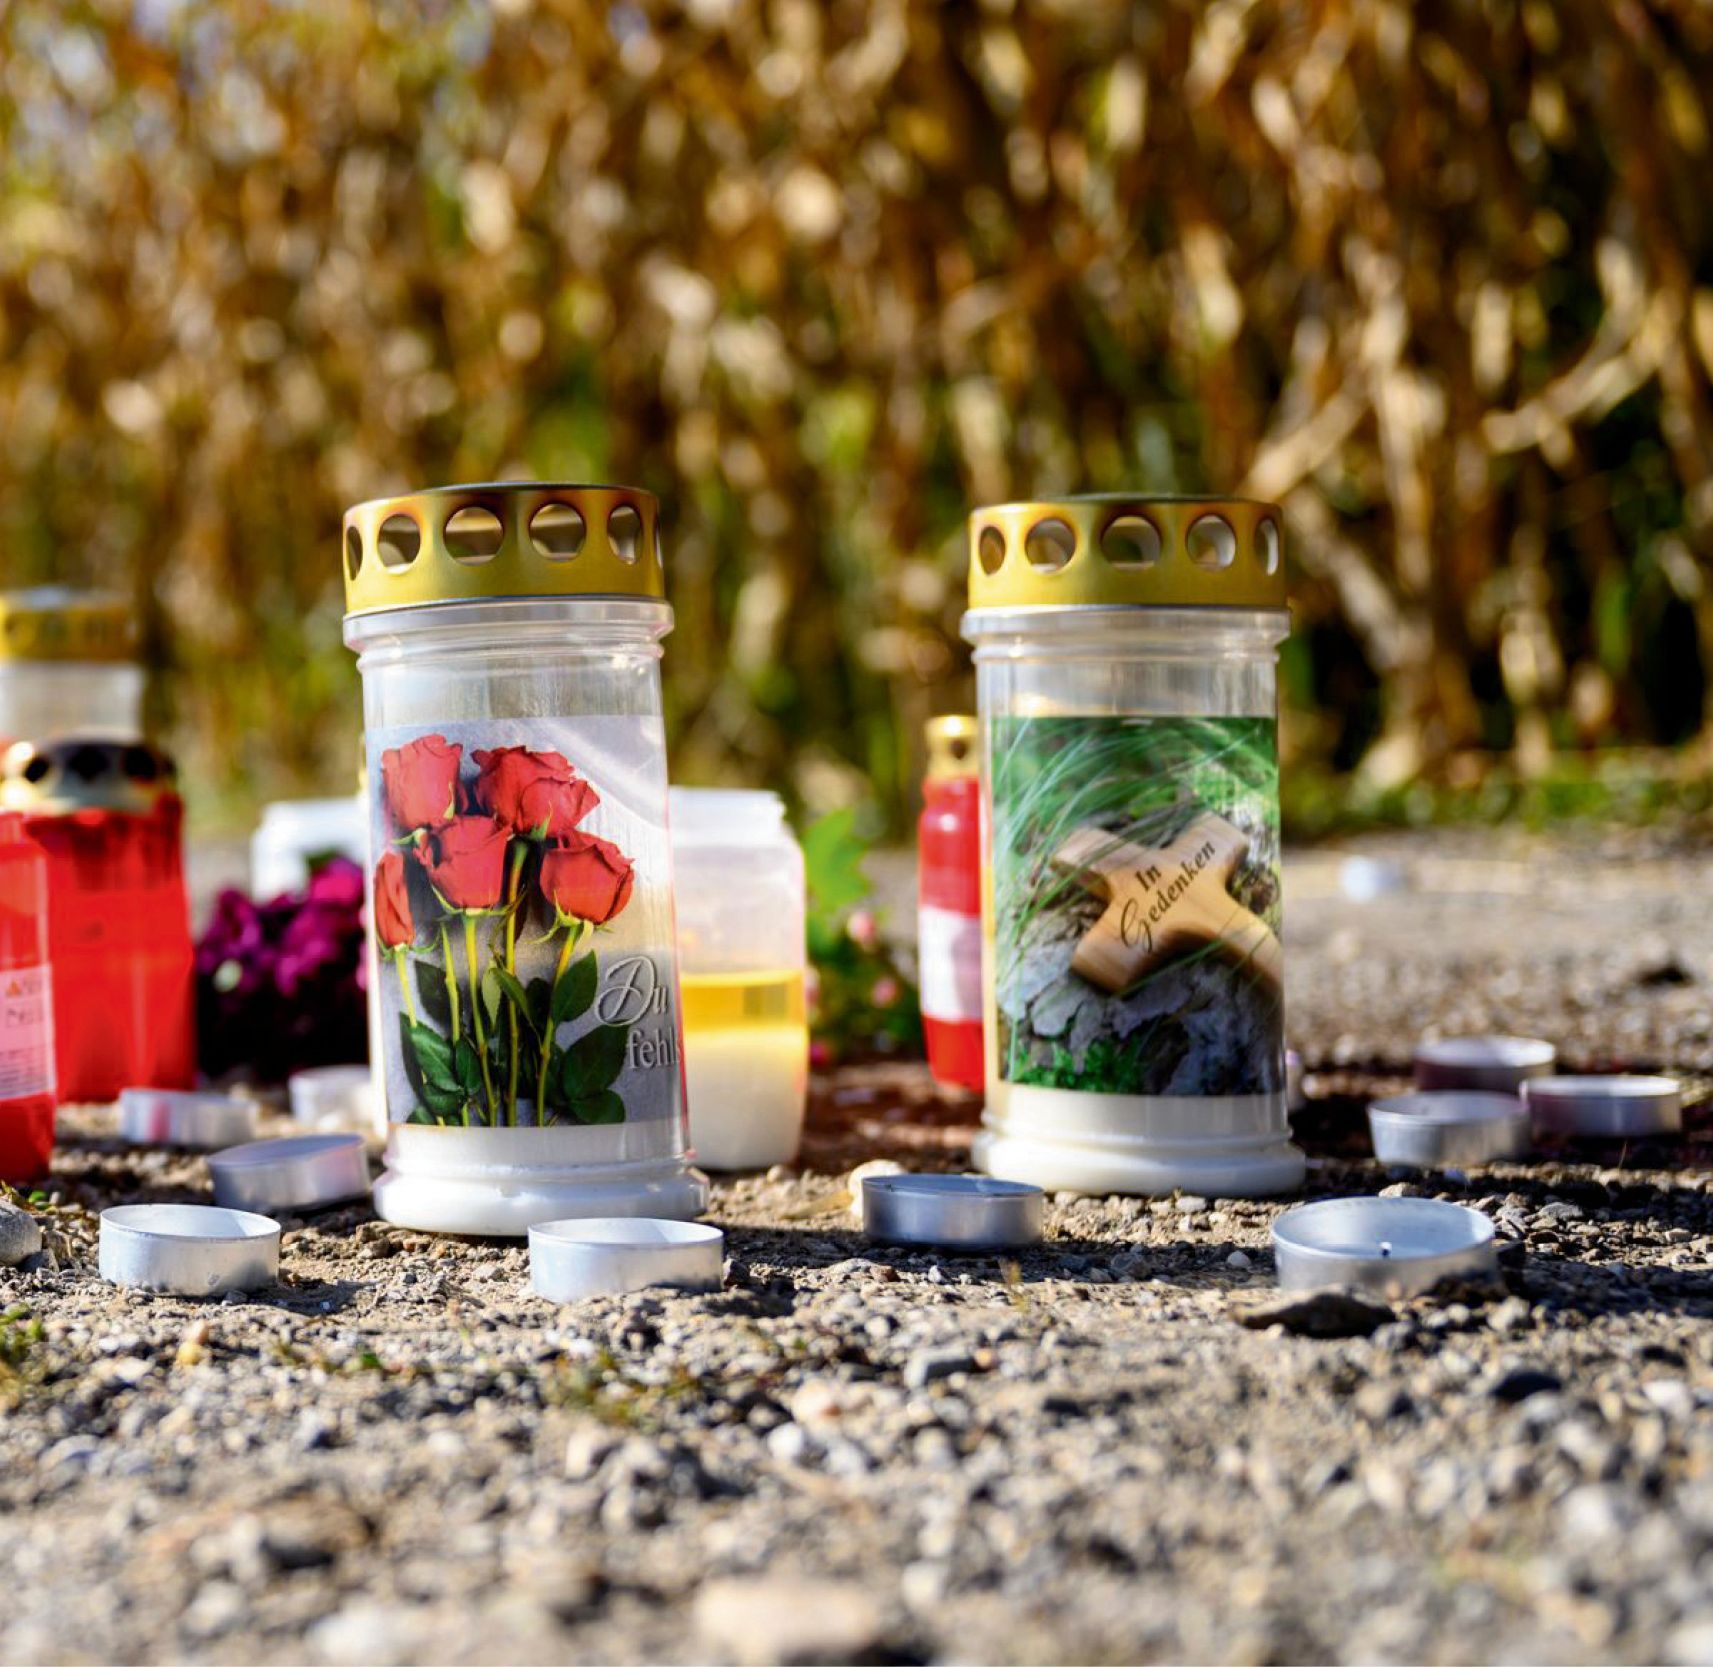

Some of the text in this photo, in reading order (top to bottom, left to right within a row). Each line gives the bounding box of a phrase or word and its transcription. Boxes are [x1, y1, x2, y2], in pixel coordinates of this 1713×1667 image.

[1120, 841, 1216, 953] Gedenken
[1135, 865, 1162, 892] In
[594, 955, 670, 1027] Du
